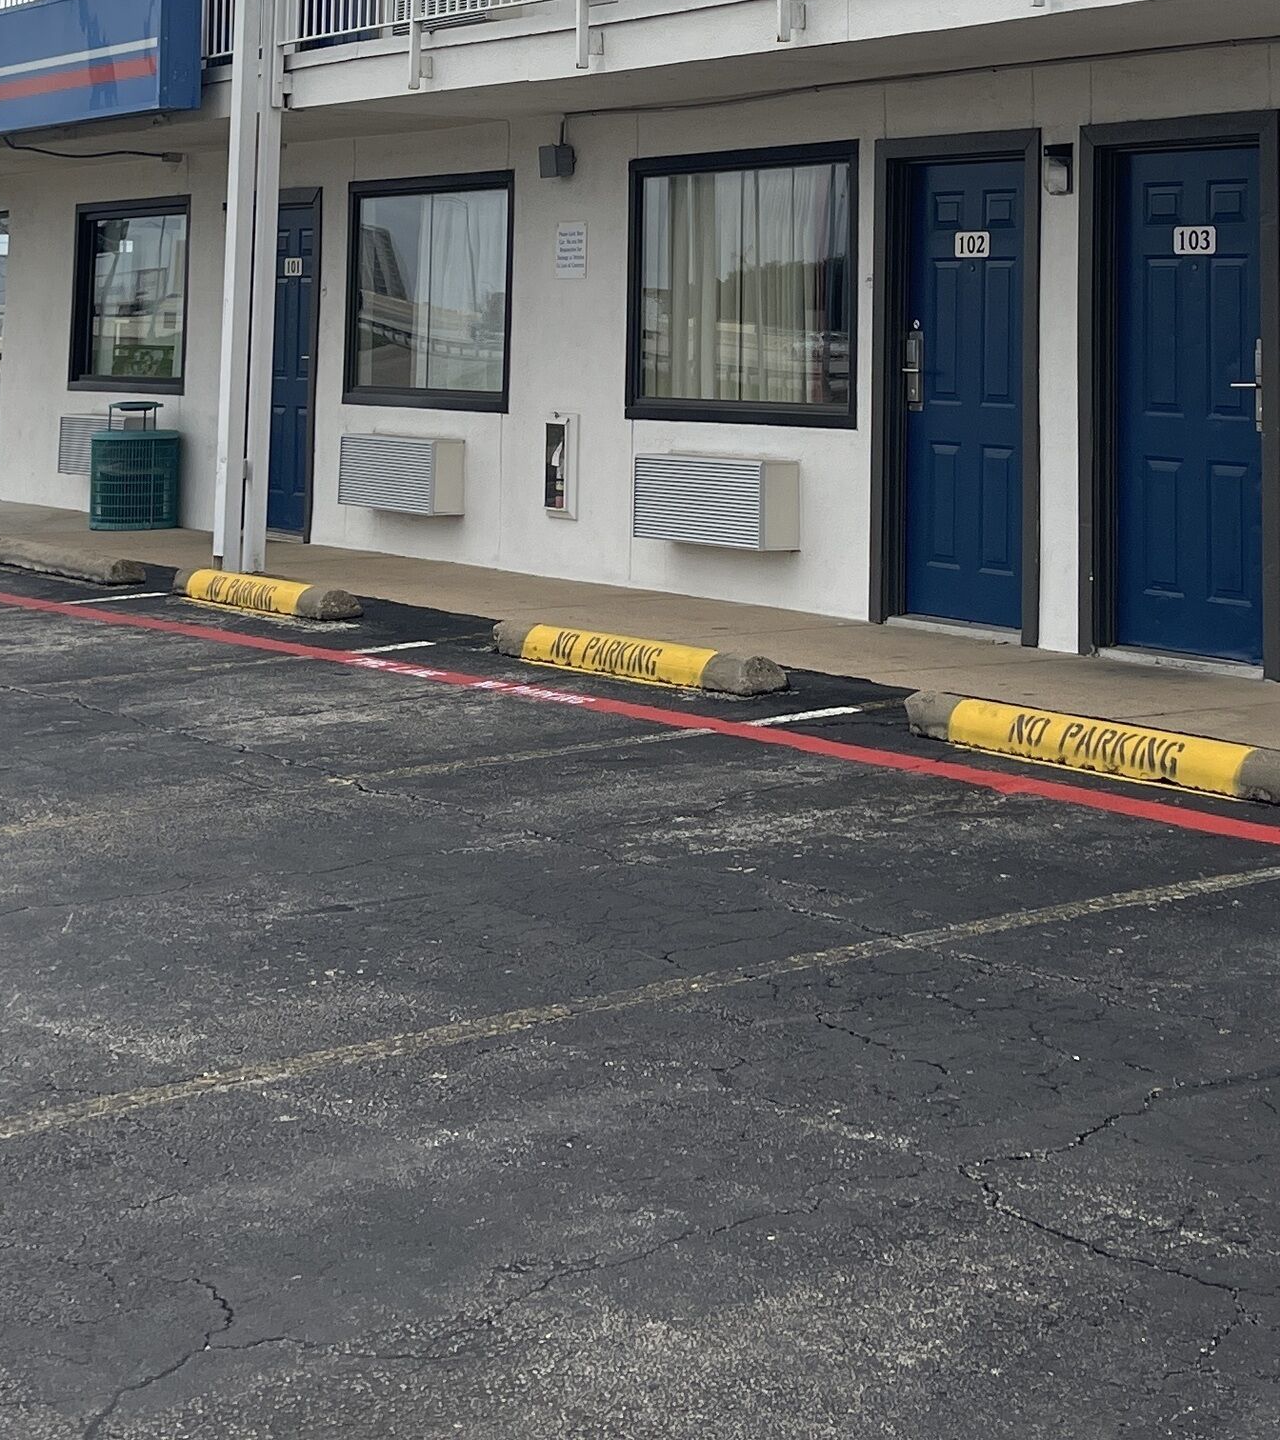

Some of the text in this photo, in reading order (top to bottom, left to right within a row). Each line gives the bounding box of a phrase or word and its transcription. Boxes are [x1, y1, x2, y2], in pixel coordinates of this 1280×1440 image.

[959, 235, 985, 254] 102
[1179, 230, 1210, 250] 103
[287, 260, 300, 274] 101
[206, 575, 277, 611] NO PARKING
[550, 631, 663, 676] NO PARKING
[1008, 713, 1185, 778] NO PARKING
